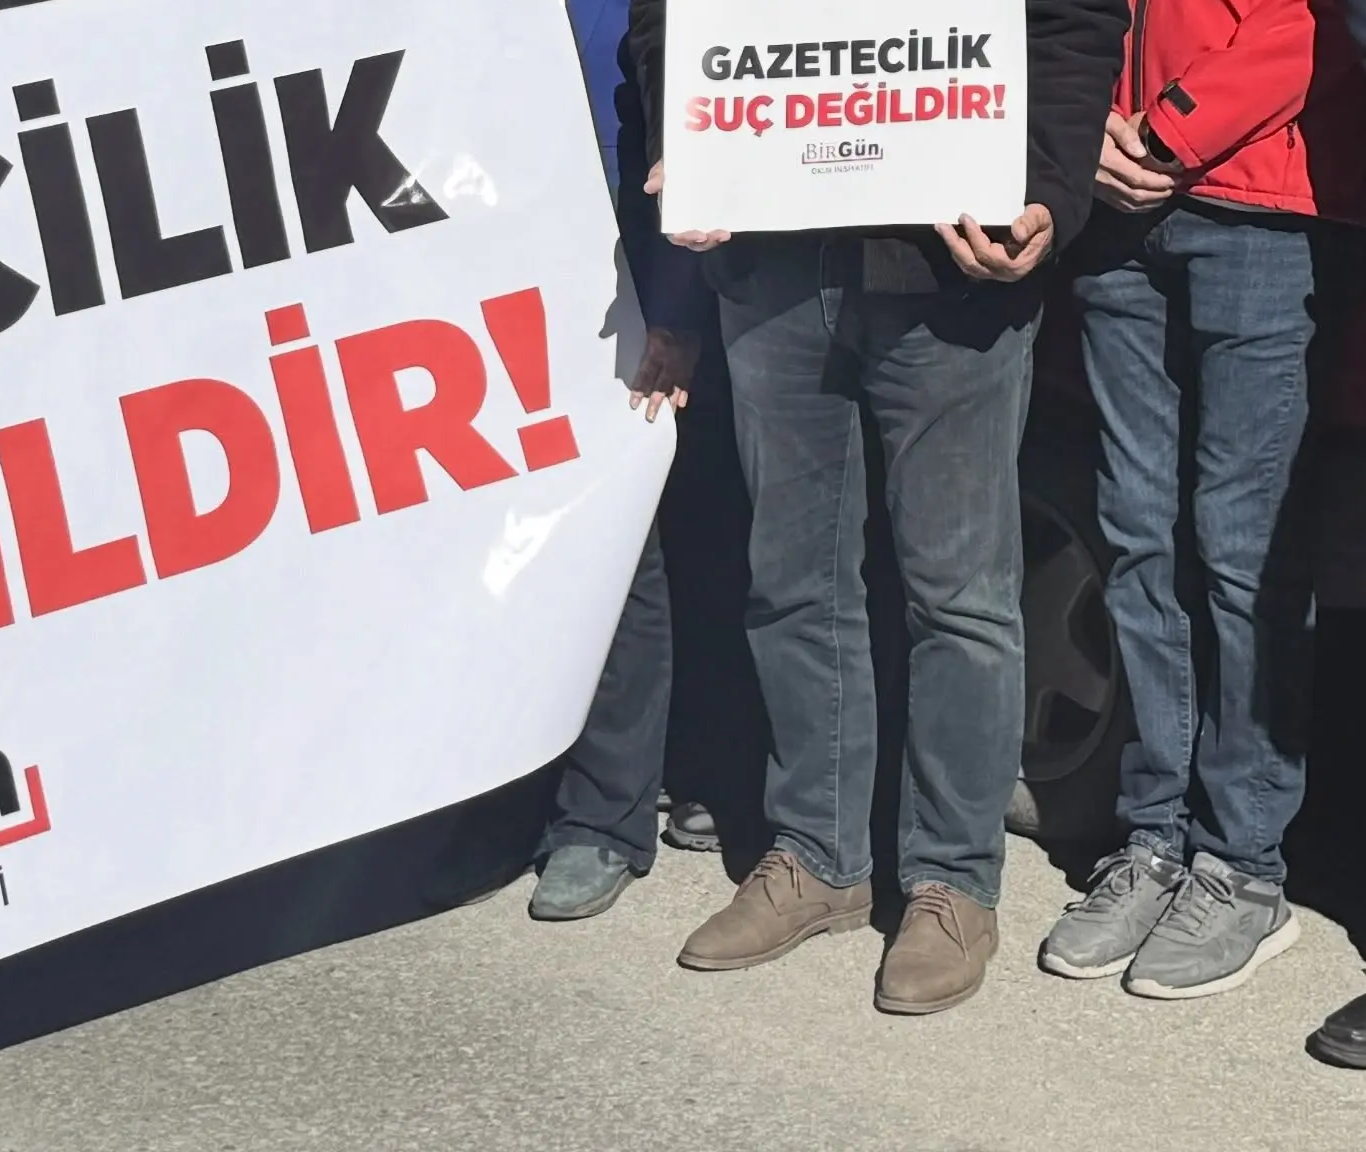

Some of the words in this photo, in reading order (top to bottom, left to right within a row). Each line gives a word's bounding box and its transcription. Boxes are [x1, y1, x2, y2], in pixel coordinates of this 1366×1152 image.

[701, 26, 992, 81] GAZETECİLİK
[685, 94, 775, 138] SUÇ
[785, 77, 1006, 129] DEĞİLDİR!
